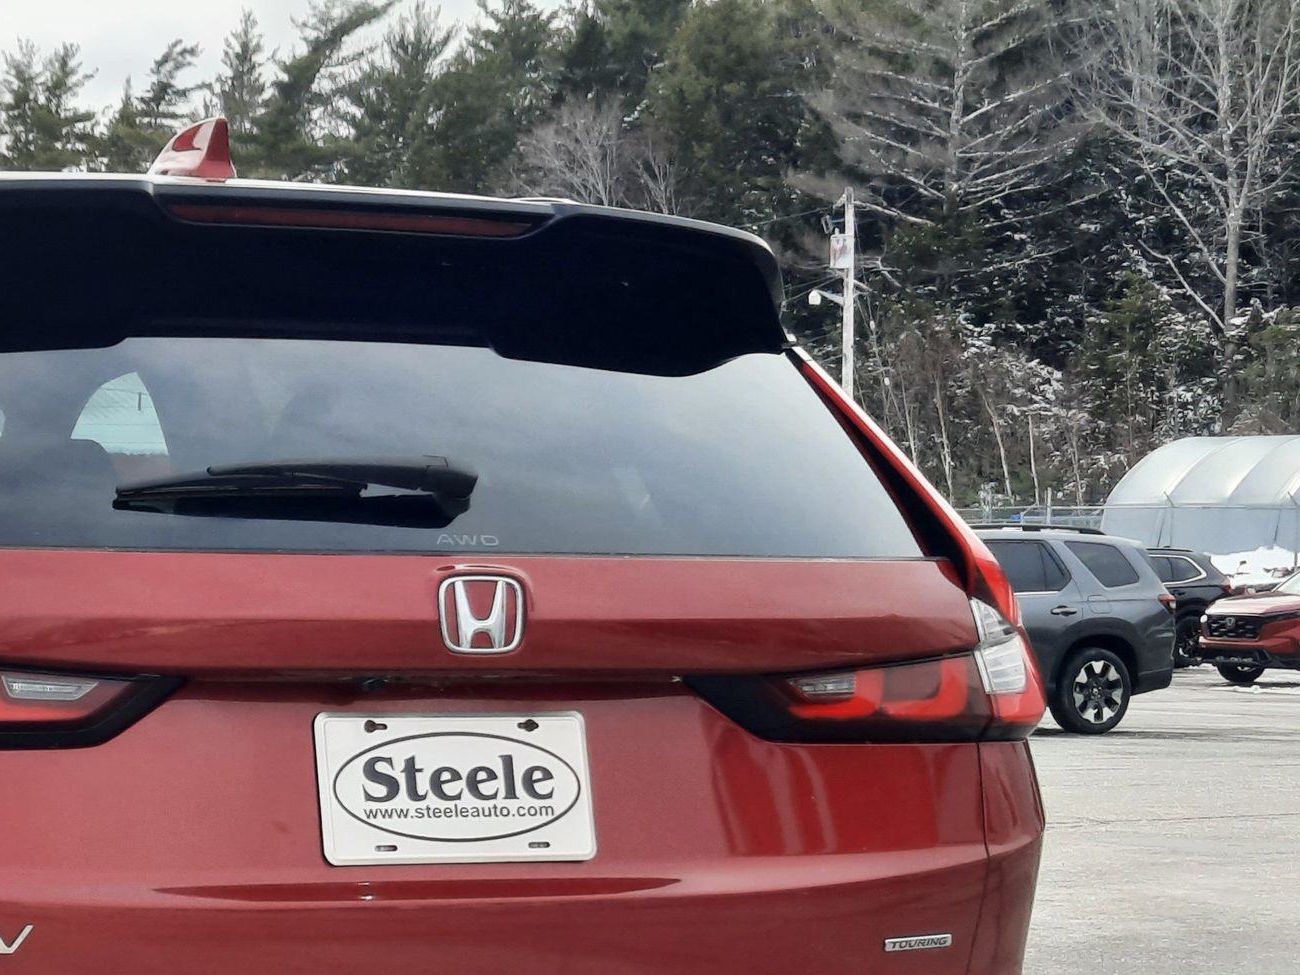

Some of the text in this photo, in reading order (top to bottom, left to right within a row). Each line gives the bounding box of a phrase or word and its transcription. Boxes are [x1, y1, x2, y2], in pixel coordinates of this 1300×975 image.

[436, 533, 500, 546] AWD
[362, 754, 555, 803] Steele
[363, 803, 555, 820] www.steeleauto.com
[890, 936, 949, 949] TOURING
